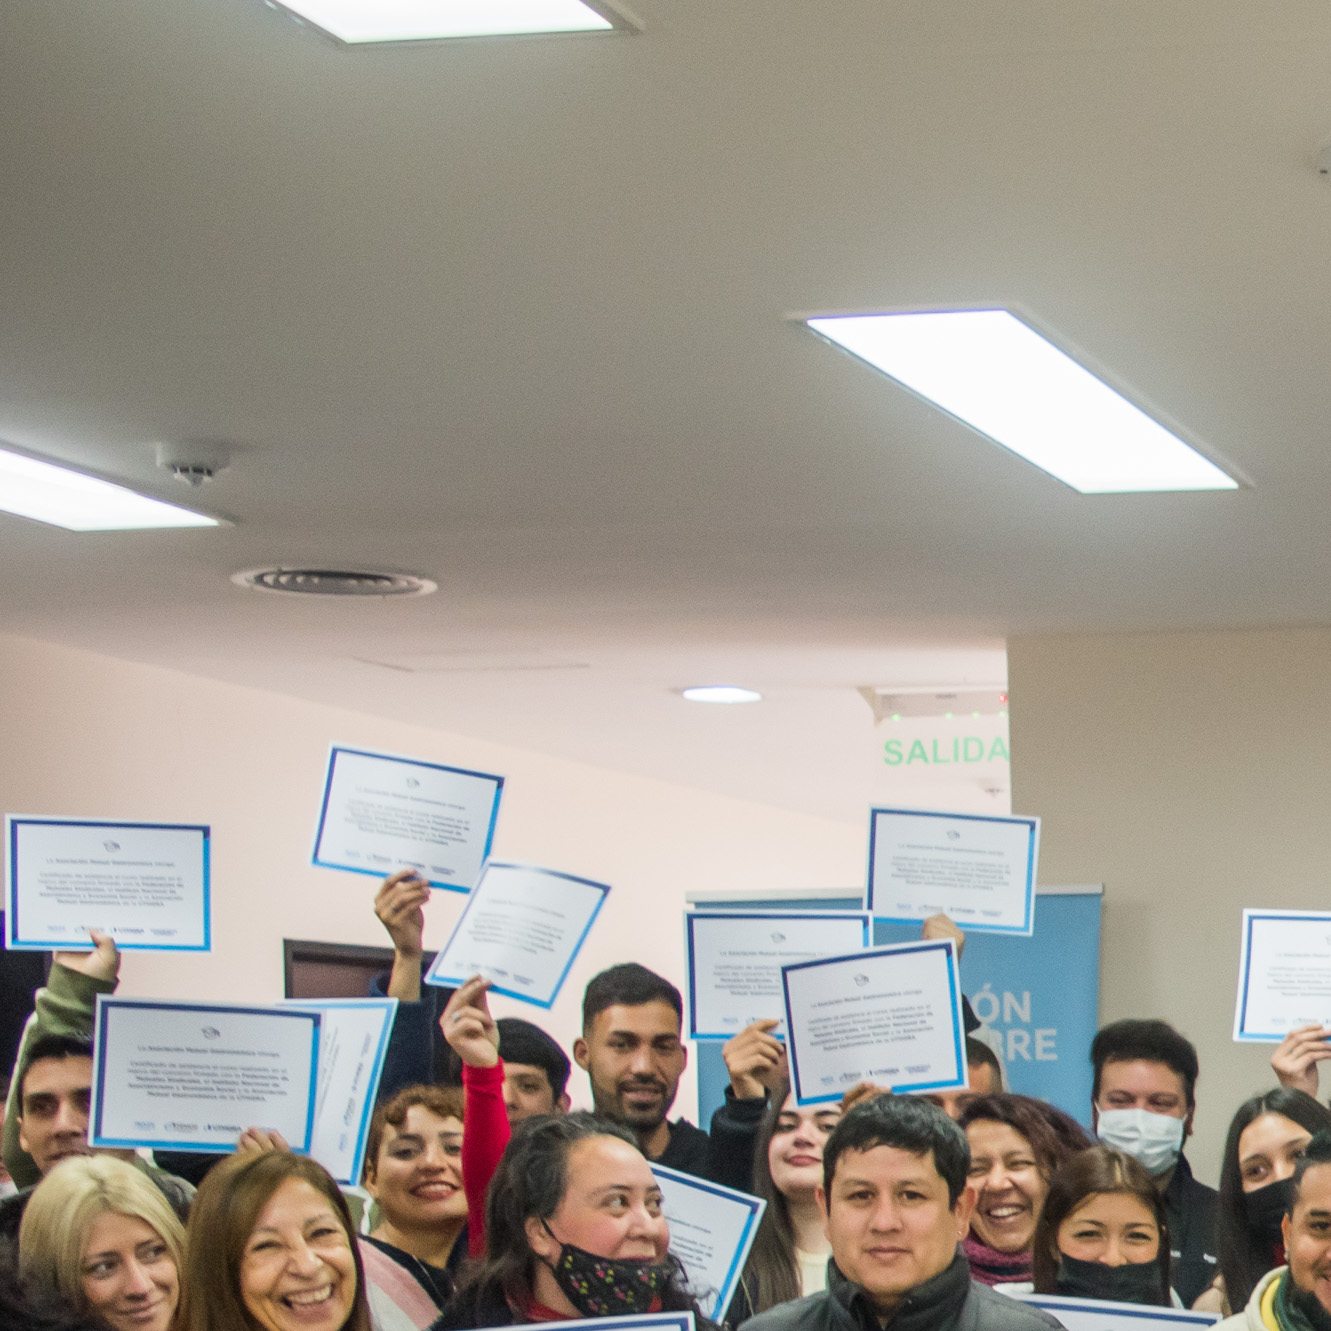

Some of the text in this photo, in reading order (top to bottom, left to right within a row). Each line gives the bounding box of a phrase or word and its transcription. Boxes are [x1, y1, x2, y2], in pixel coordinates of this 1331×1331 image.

[884, 736, 1010, 766] SALIDA
[971, 983, 1032, 1024] ÓN
[1006, 1028, 1058, 1062] RE
